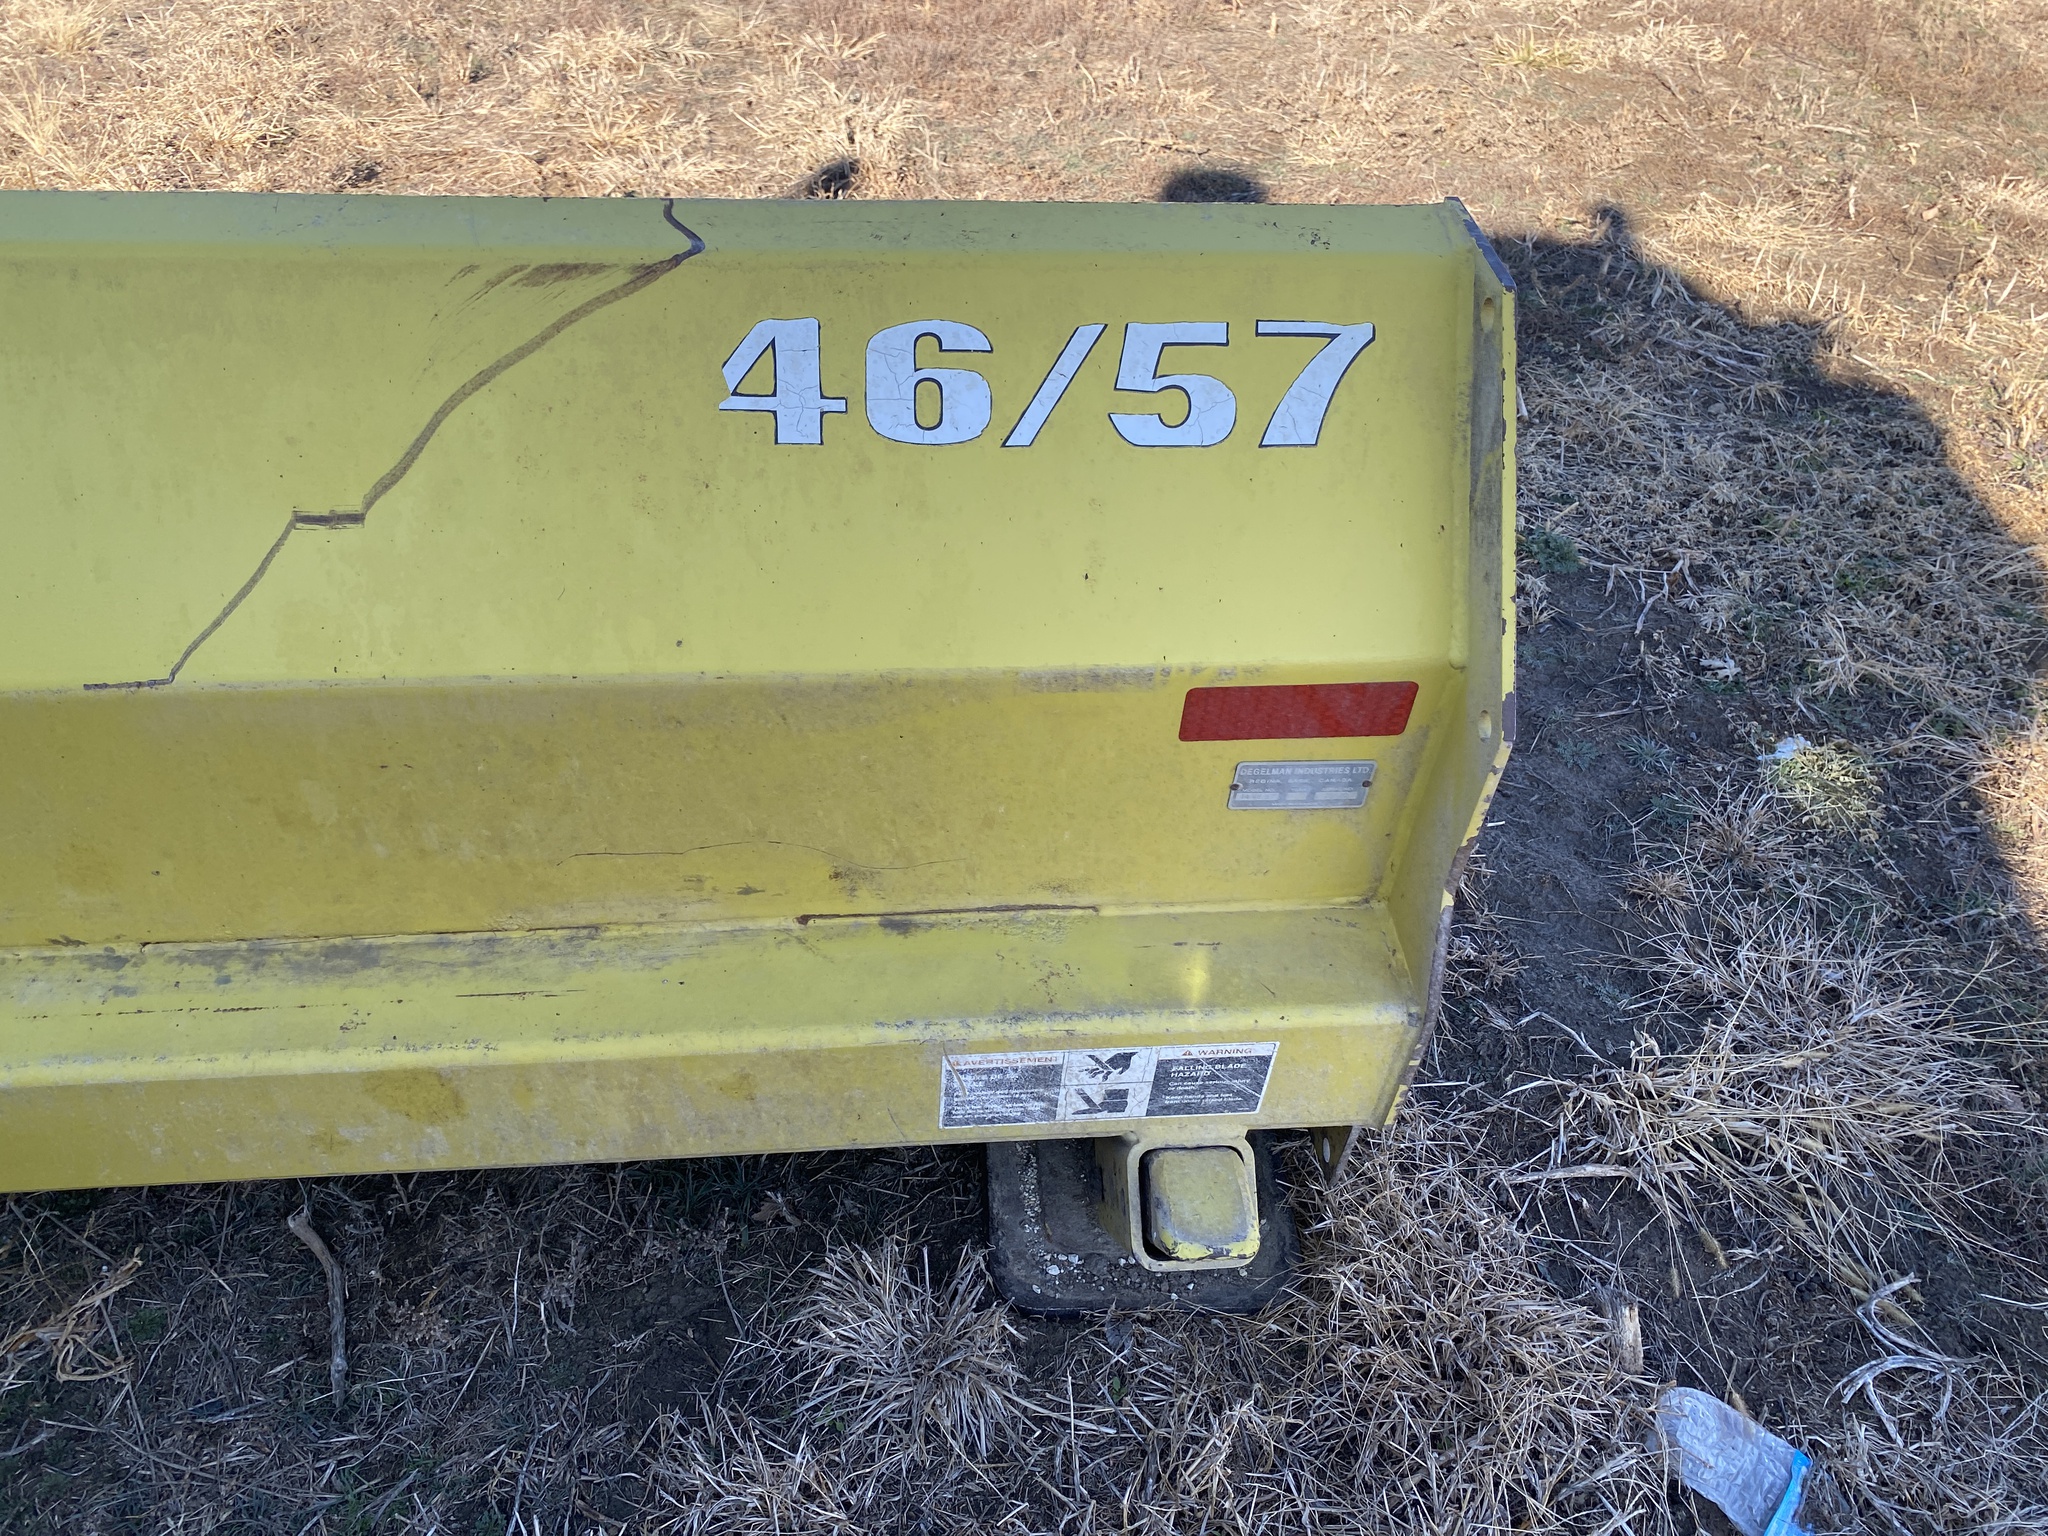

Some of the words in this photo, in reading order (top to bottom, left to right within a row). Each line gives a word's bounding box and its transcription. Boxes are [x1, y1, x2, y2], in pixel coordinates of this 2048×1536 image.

[719, 317, 1376, 448] 46/57
[1239, 767, 1292, 776] DEGELMAN
[1294, 766, 1351, 775] INDUSTRIES
[1198, 1047, 1252, 1056] WARNING
[962, 1056, 1059, 1067] AVERTISSEMENT
[1170, 1064, 1211, 1072] FALLING
[1214, 1062, 1247, 1070] BLADE
